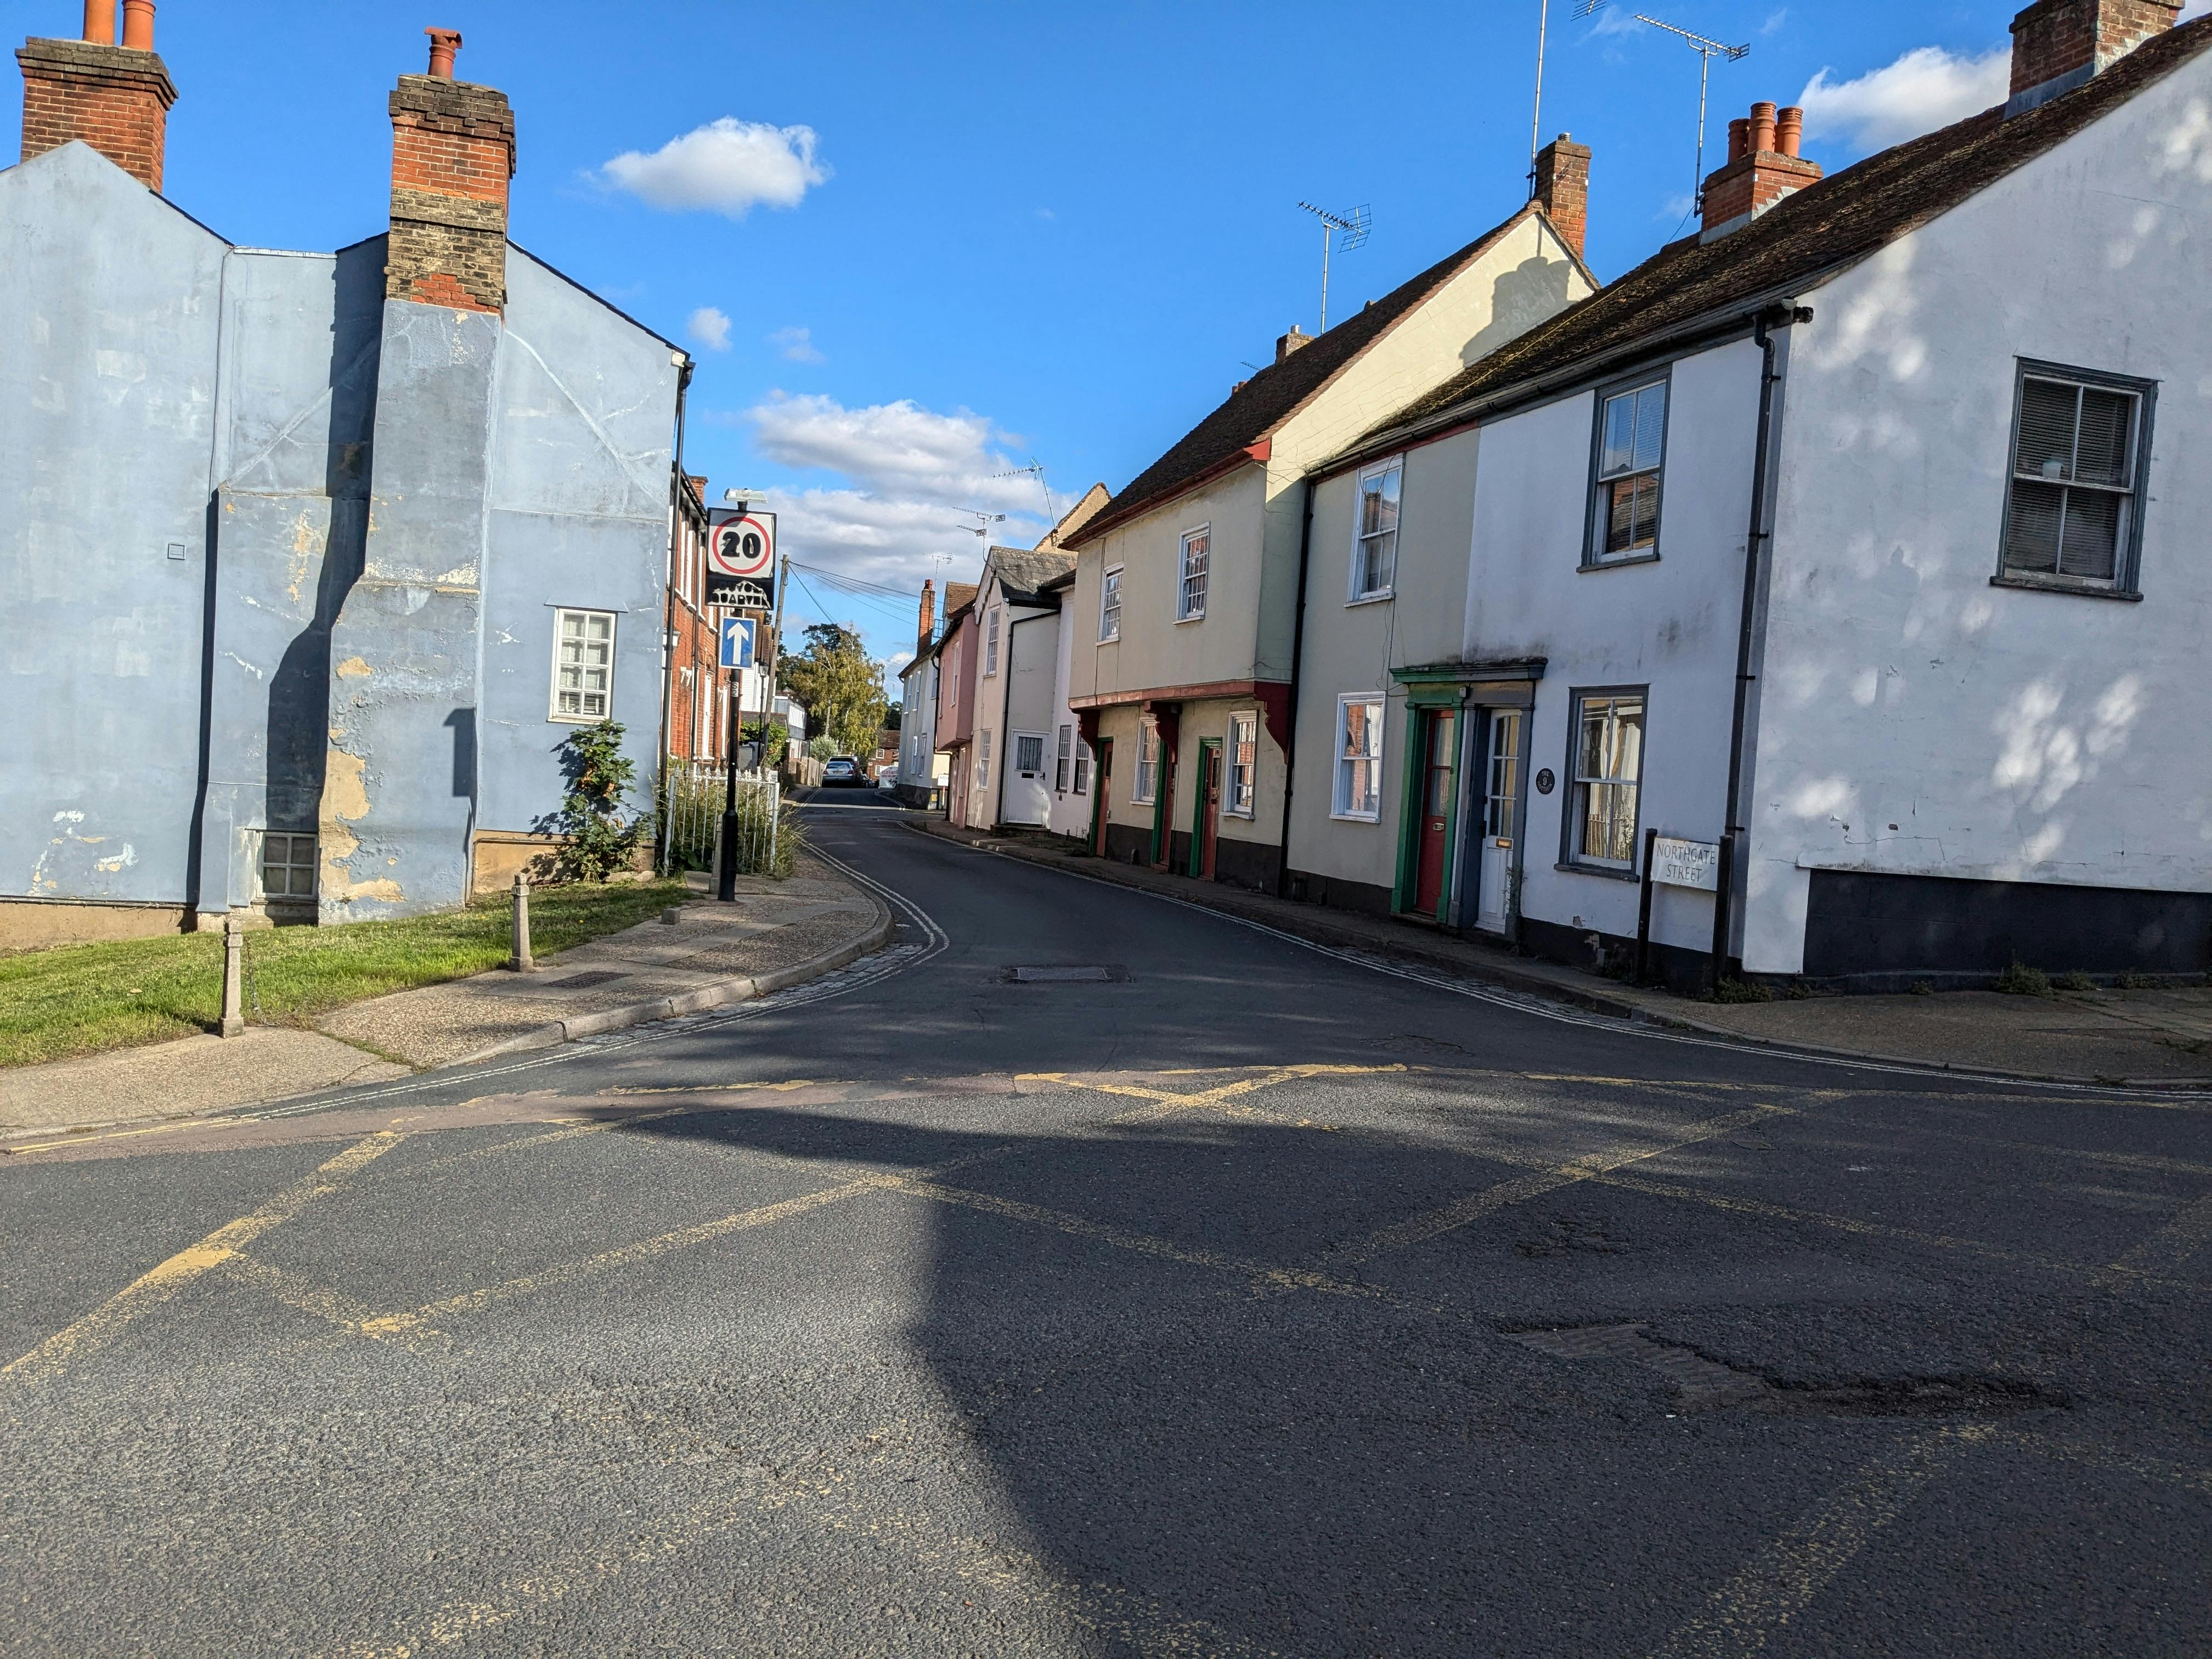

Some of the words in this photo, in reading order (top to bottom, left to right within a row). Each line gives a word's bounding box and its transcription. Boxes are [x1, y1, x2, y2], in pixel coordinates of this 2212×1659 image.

[721, 531, 761, 559] 20
[1543, 777, 1547, 786] 9
[1656, 843, 1715, 865] NORTHGATE
[1666, 864, 1702, 882] STREET
